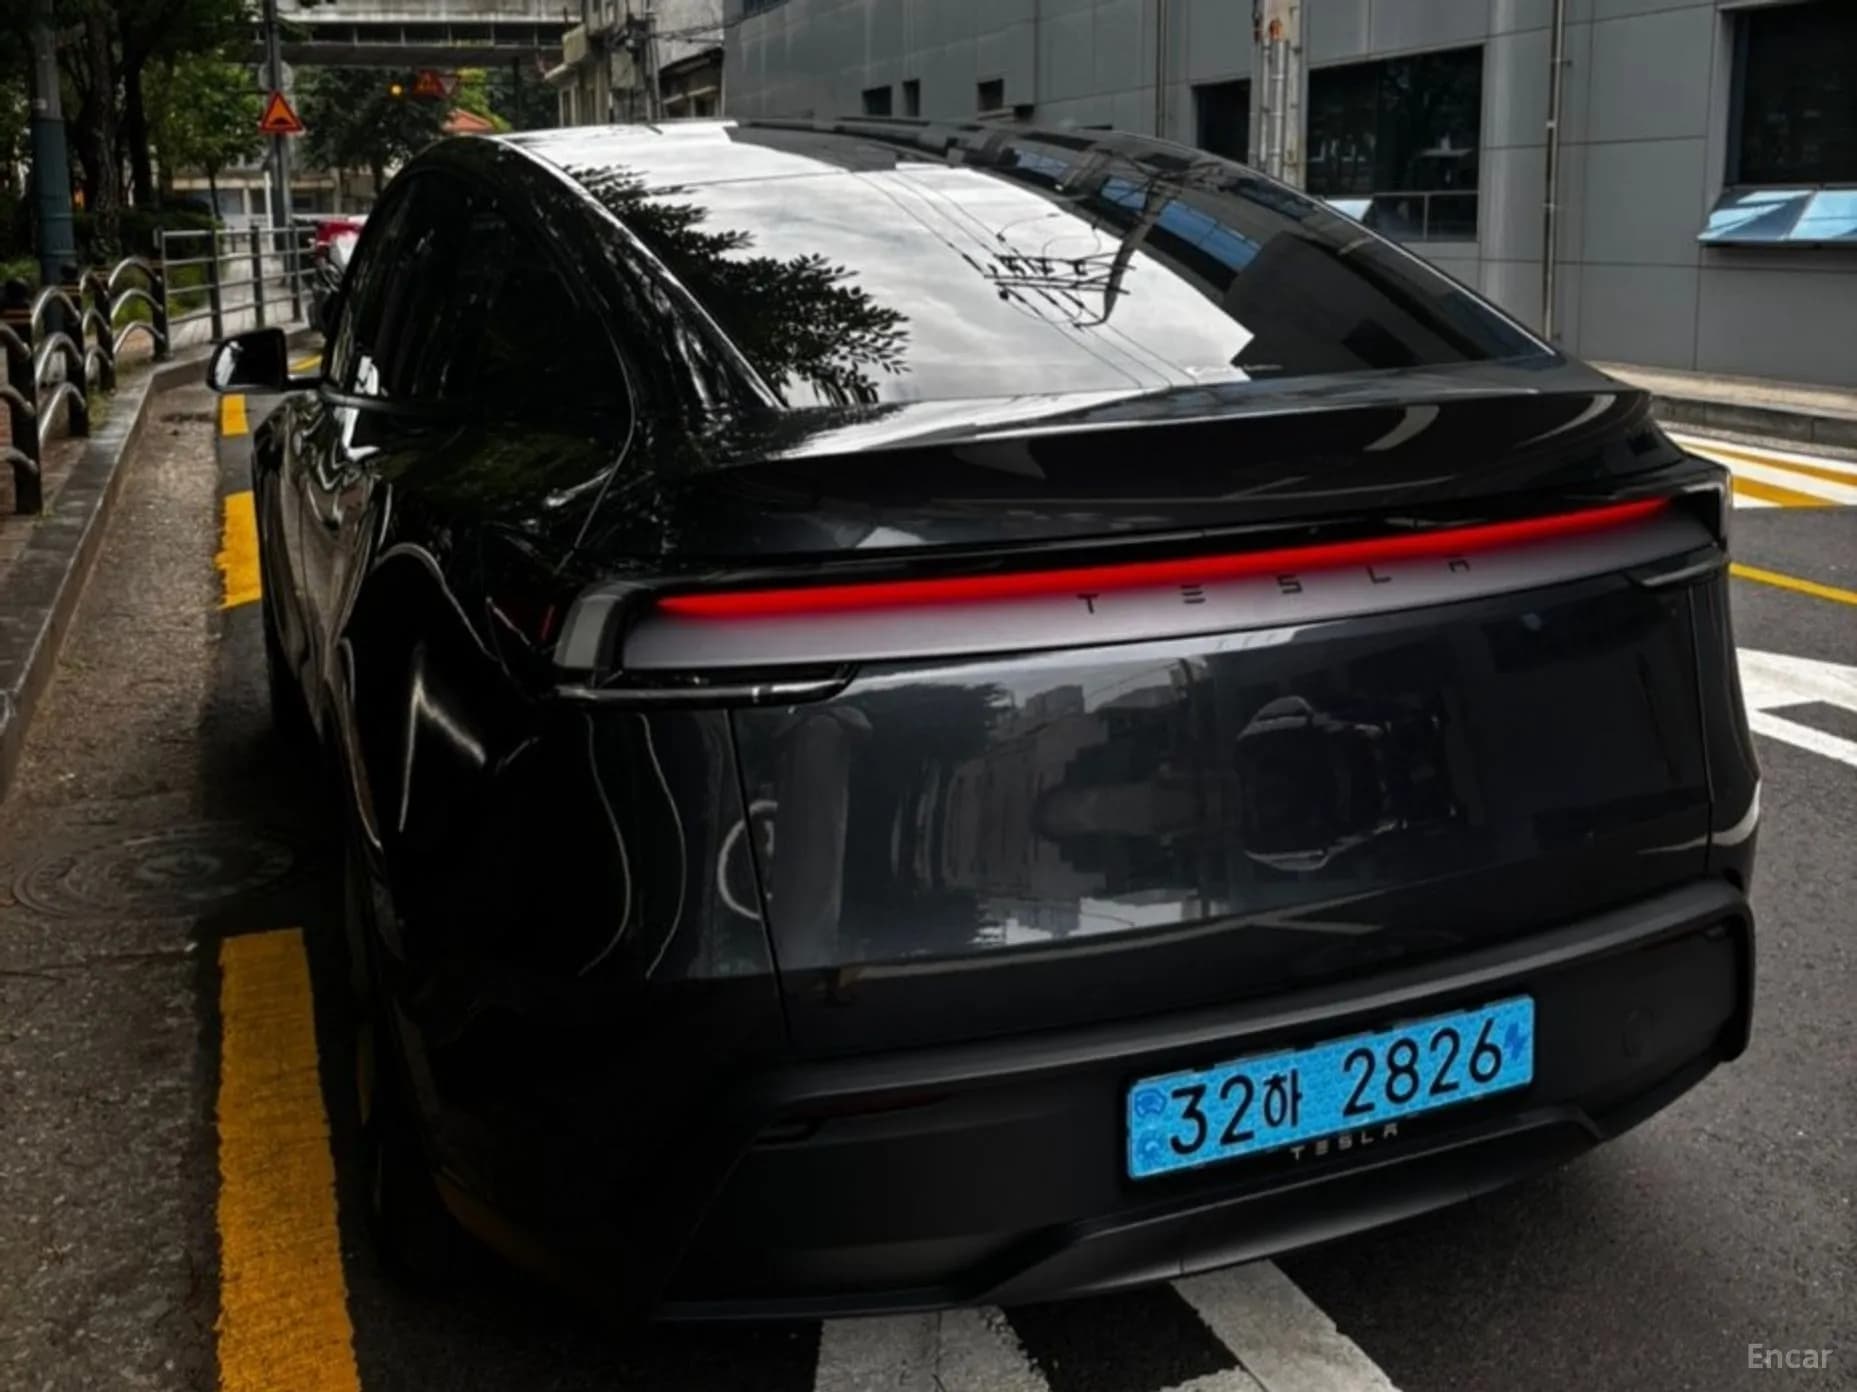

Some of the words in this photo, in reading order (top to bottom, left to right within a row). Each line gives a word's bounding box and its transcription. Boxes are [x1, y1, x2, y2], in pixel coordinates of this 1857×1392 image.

[1076, 554, 1471, 614] TESLA
[1168, 1068, 1304, 1156] 32하
[1342, 1018, 1502, 1119] 2826
[1290, 1122, 1399, 1161] TESLA
